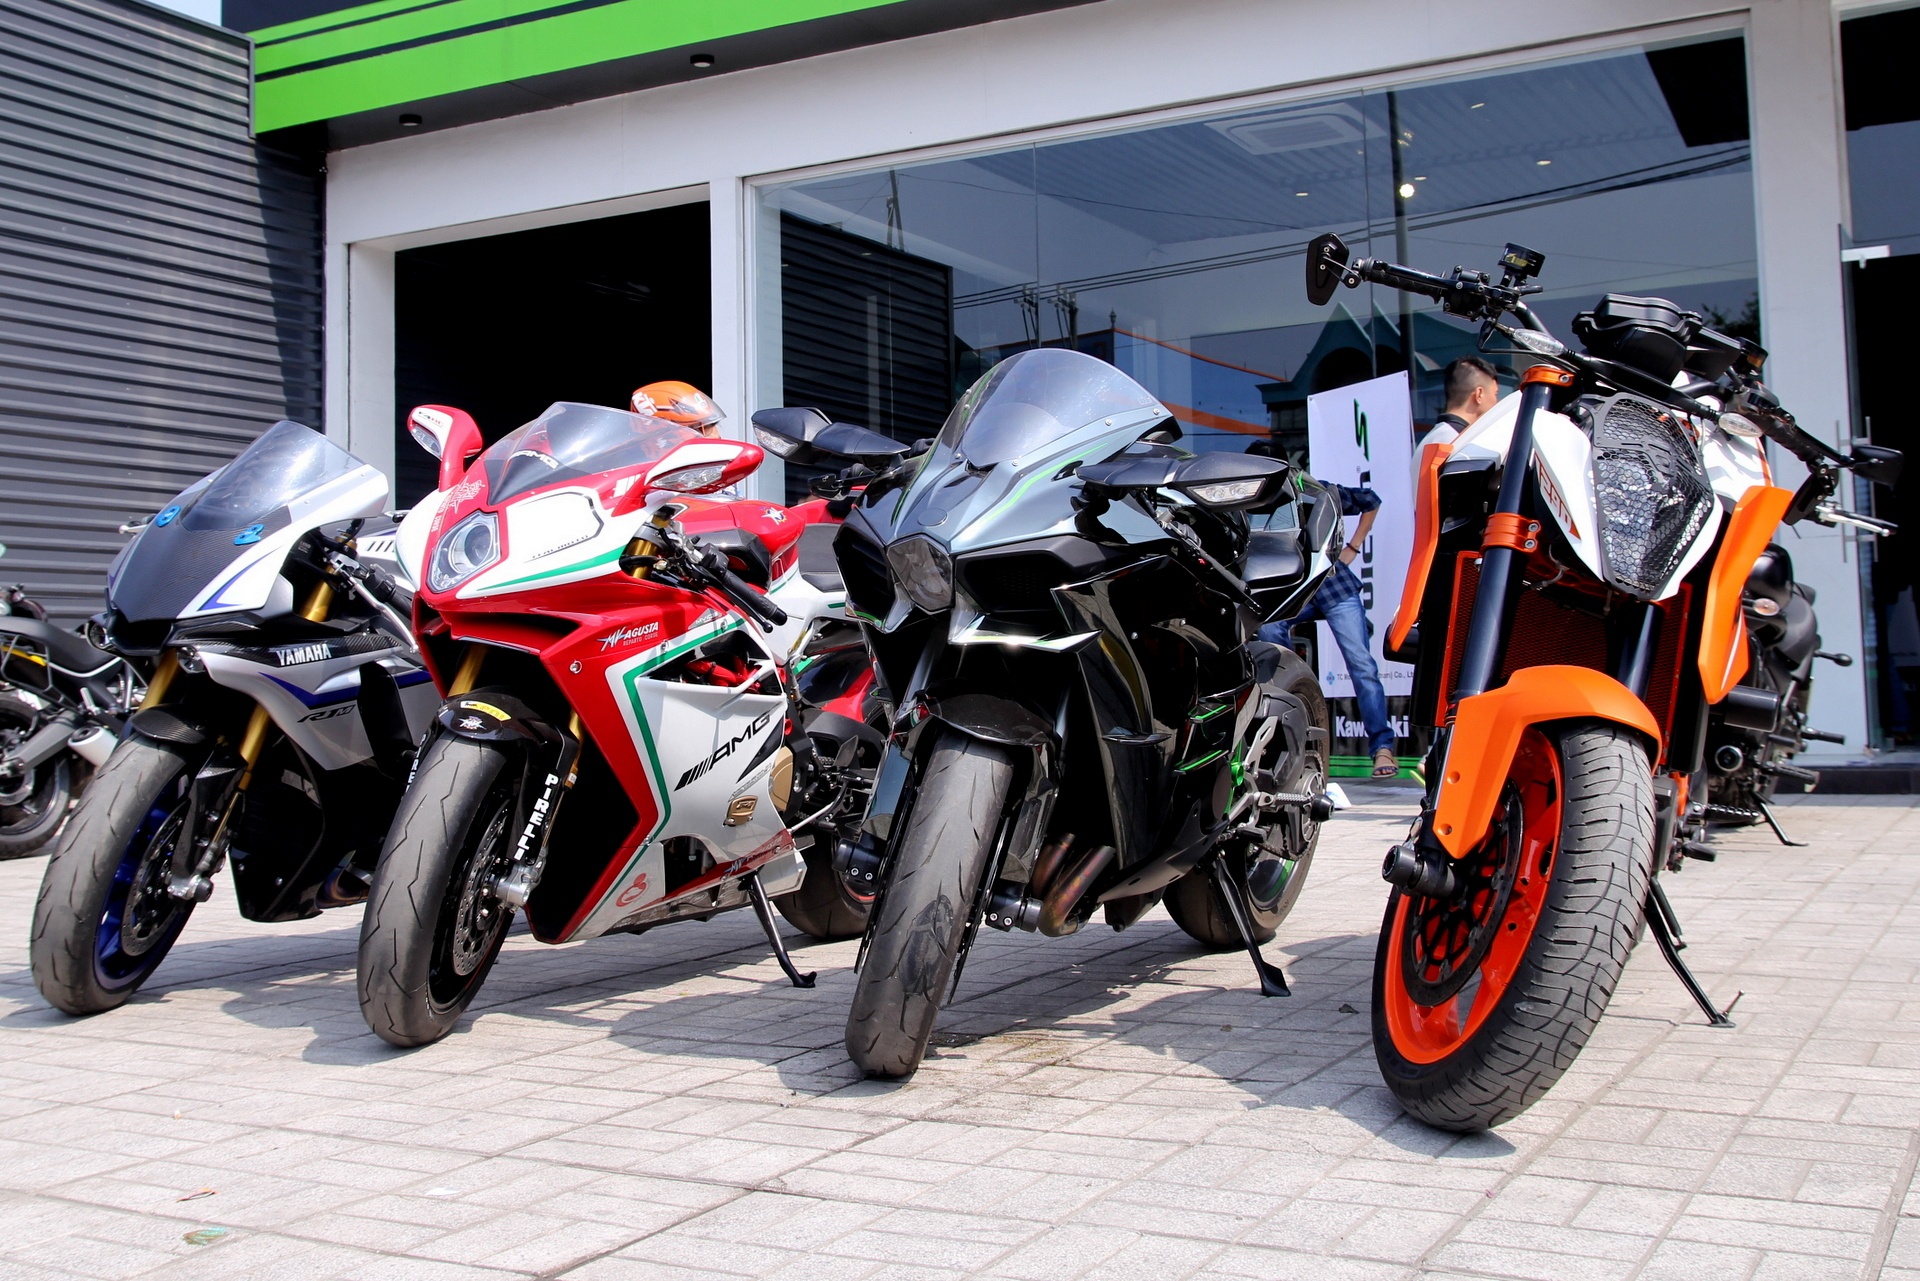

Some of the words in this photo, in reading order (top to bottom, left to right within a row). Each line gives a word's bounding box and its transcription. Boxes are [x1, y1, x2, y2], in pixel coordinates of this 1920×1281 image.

[622, 636, 643, 647] REPARTO
[644, 631, 659, 641] CORSE
[624, 621, 660, 640] AGUSTA
[276, 643, 332, 666] YAMAHA
[1335, 715, 1409, 737] Kawki
[708, 711, 770, 771] AMG
[514, 773, 559, 861] PIRELLI
